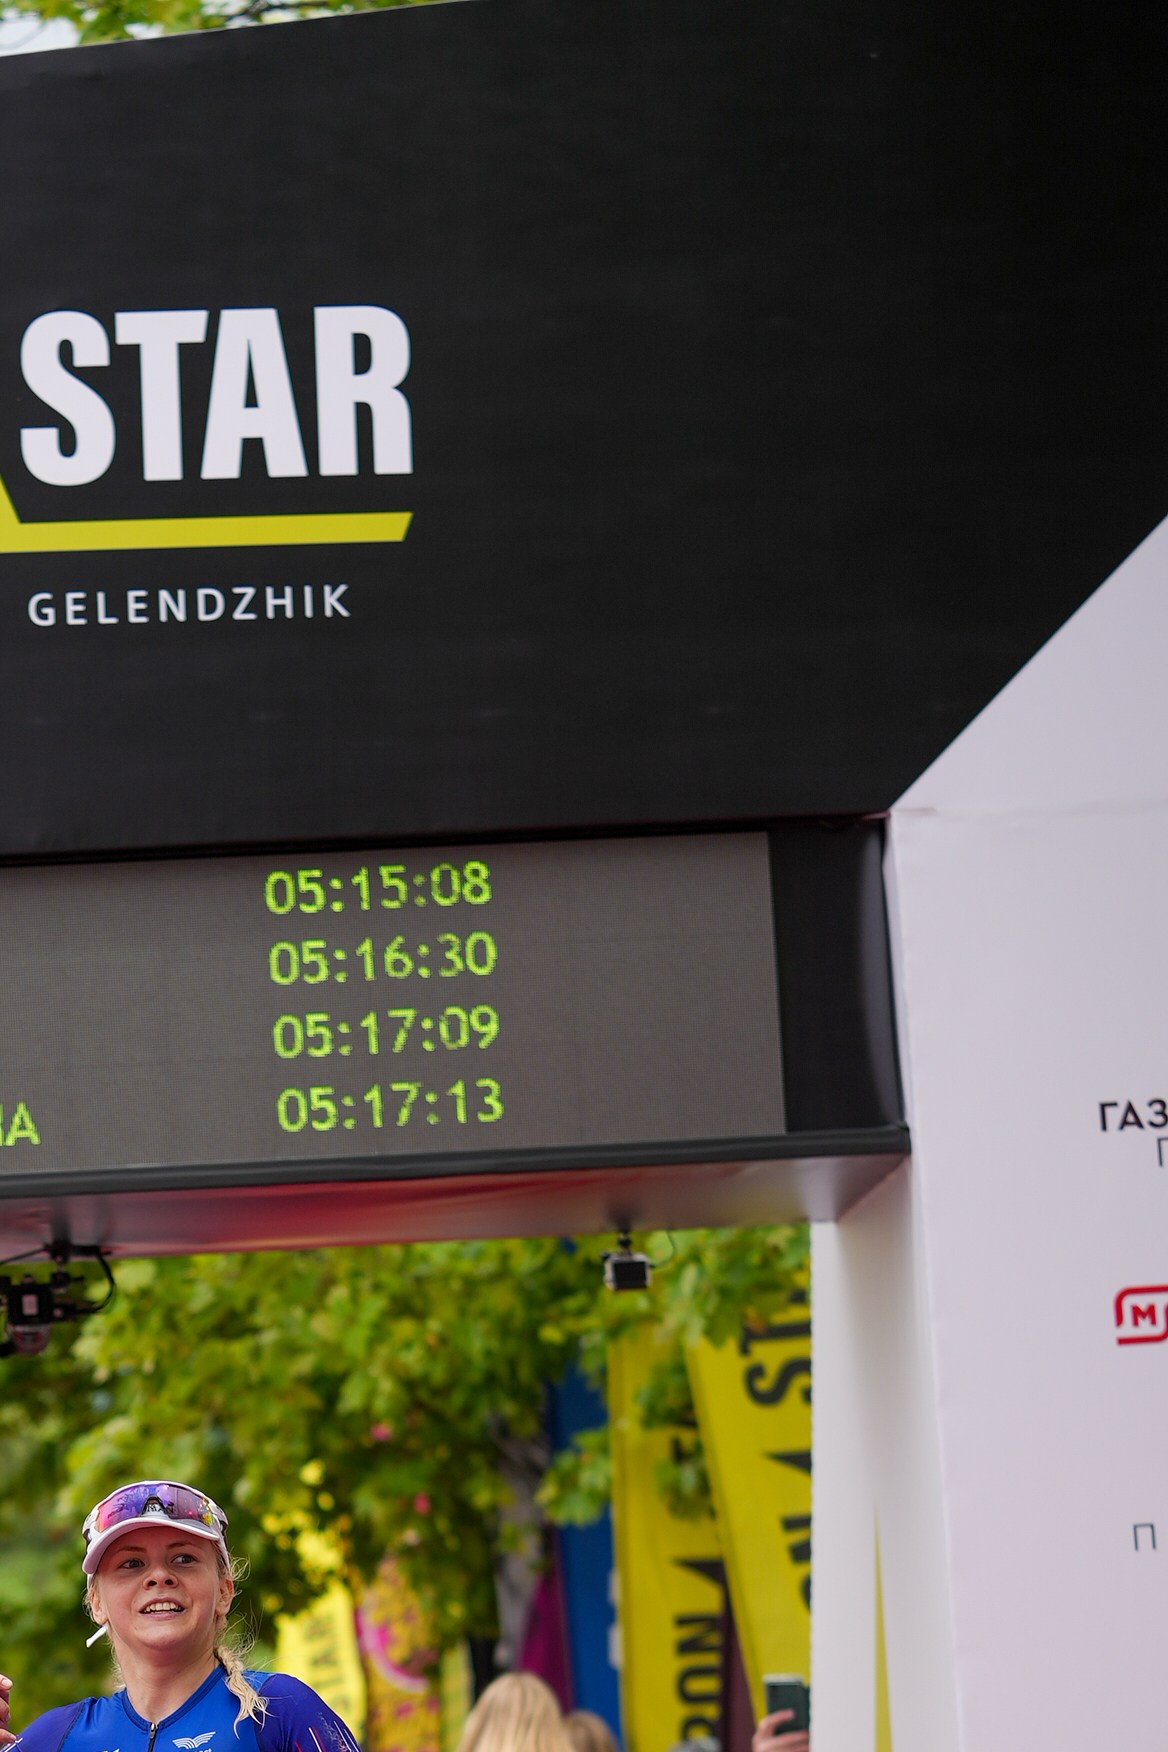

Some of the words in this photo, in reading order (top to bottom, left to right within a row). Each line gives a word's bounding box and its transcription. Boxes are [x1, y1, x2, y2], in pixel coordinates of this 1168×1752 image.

[19, 304, 413, 487] STAR
[27, 583, 352, 628] GELENDZHIK
[264, 860, 493, 915] 05:15:08
[268, 930, 499, 986] 05:16:30
[272, 1004, 501, 1060] 05:17:09
[276, 1077, 505, 1133] 05:17:13
